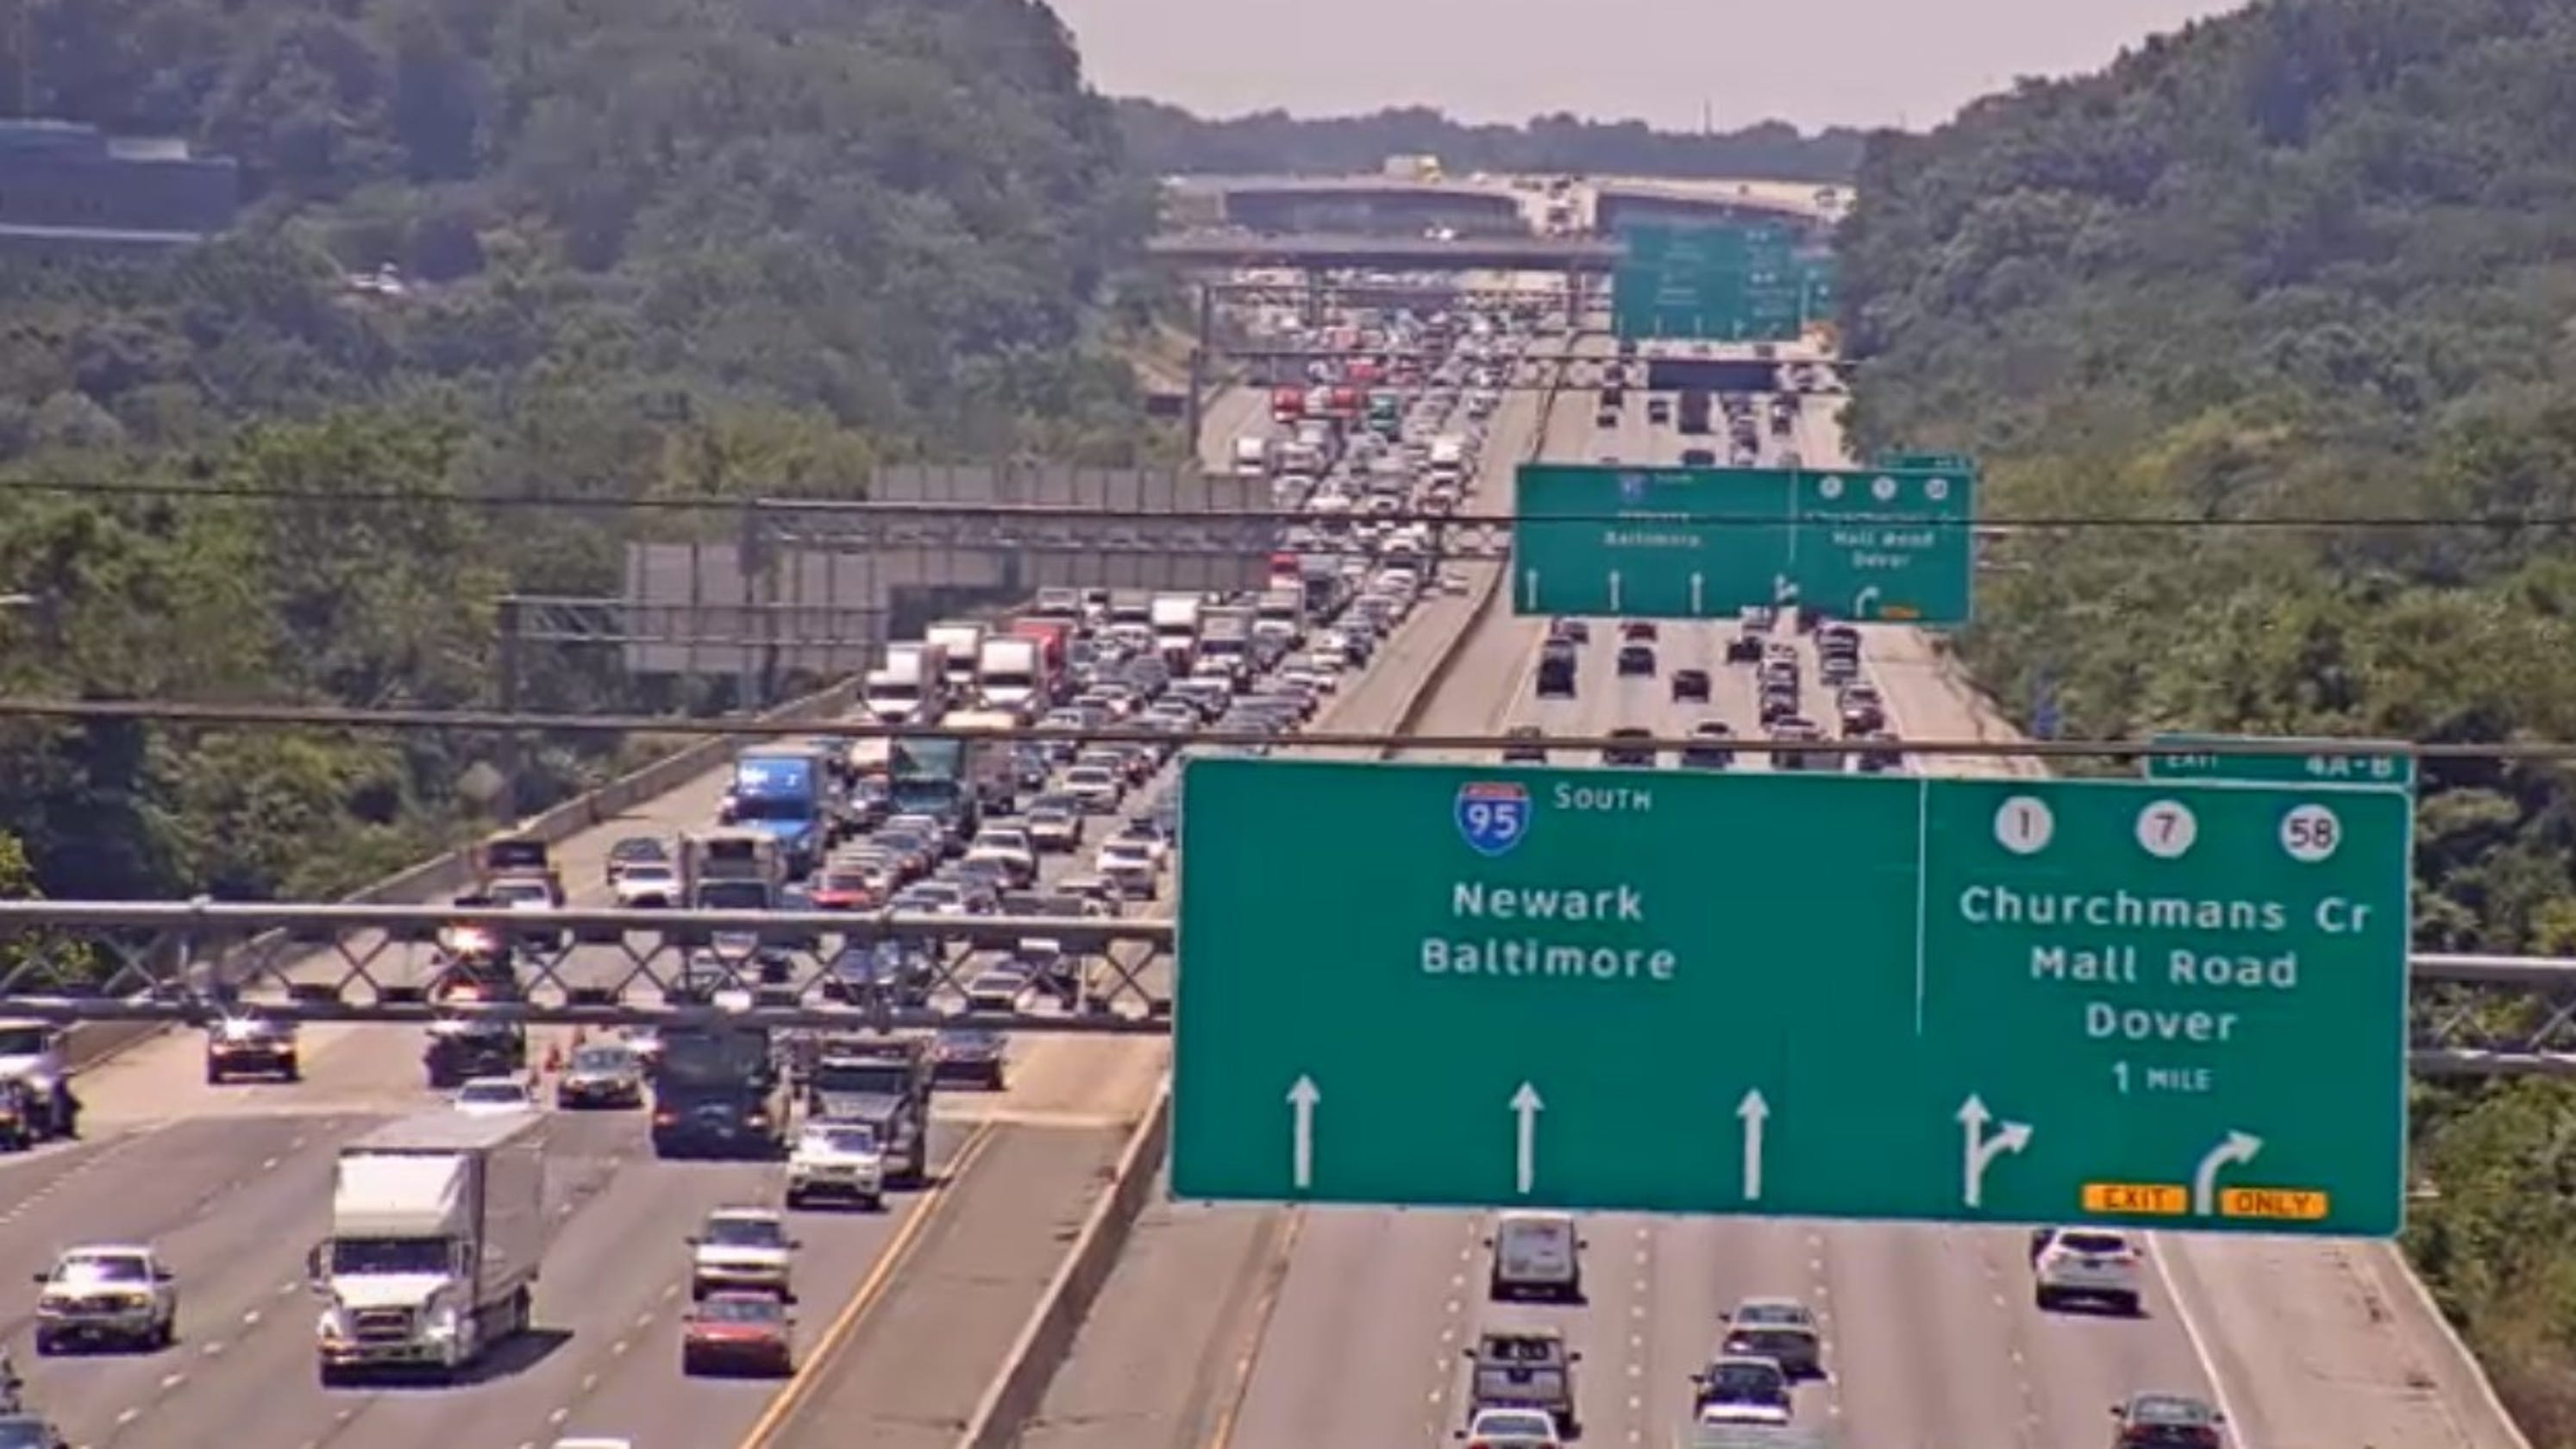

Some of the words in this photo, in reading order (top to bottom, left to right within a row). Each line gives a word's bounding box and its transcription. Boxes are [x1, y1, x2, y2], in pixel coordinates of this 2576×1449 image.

[1468, 803, 1519, 839] 95
[2016, 811, 2030, 839] 1
[2155, 812, 2176, 843] 7
[2290, 818, 2334, 850] 58
[1453, 881, 1642, 919] Newark
[1959, 885, 2286, 930] Churchmans
[2316, 897, 2372, 932] Cr
[1421, 938, 1677, 979] Baltimore
[2030, 945, 2137, 982] Mall
[2169, 950, 2297, 988] Road
[2085, 1002, 2239, 1040] Dover
[2112, 1061, 2129, 1093] 1
[2147, 1068, 2211, 1093] MILE
[2103, 1187, 2167, 1210] EXIT
[2233, 1192, 2311, 1217] ONLY
